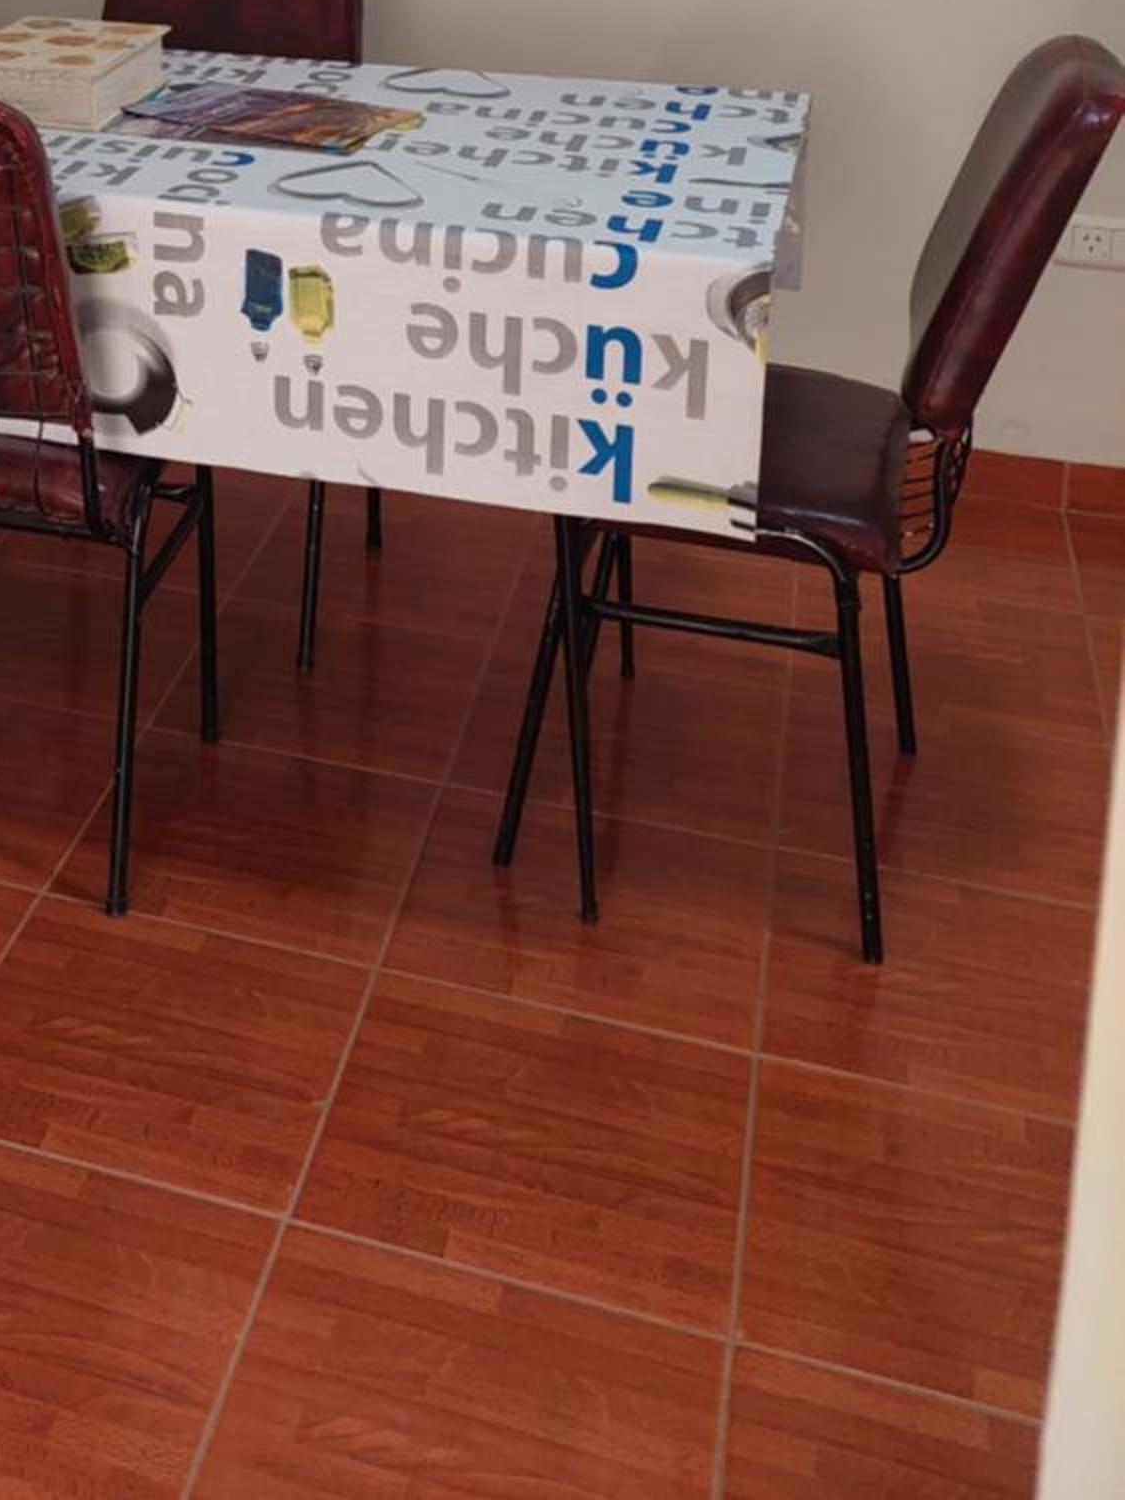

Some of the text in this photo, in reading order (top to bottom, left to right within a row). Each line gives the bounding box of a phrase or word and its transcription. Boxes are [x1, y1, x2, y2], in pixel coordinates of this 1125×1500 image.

[424, 100, 692, 135] cucina
[483, 124, 748, 166] küche
[319, 211, 640, 294] cucina
[406, 302, 710, 421] küche
[274, 374, 636, 505] kitchen
